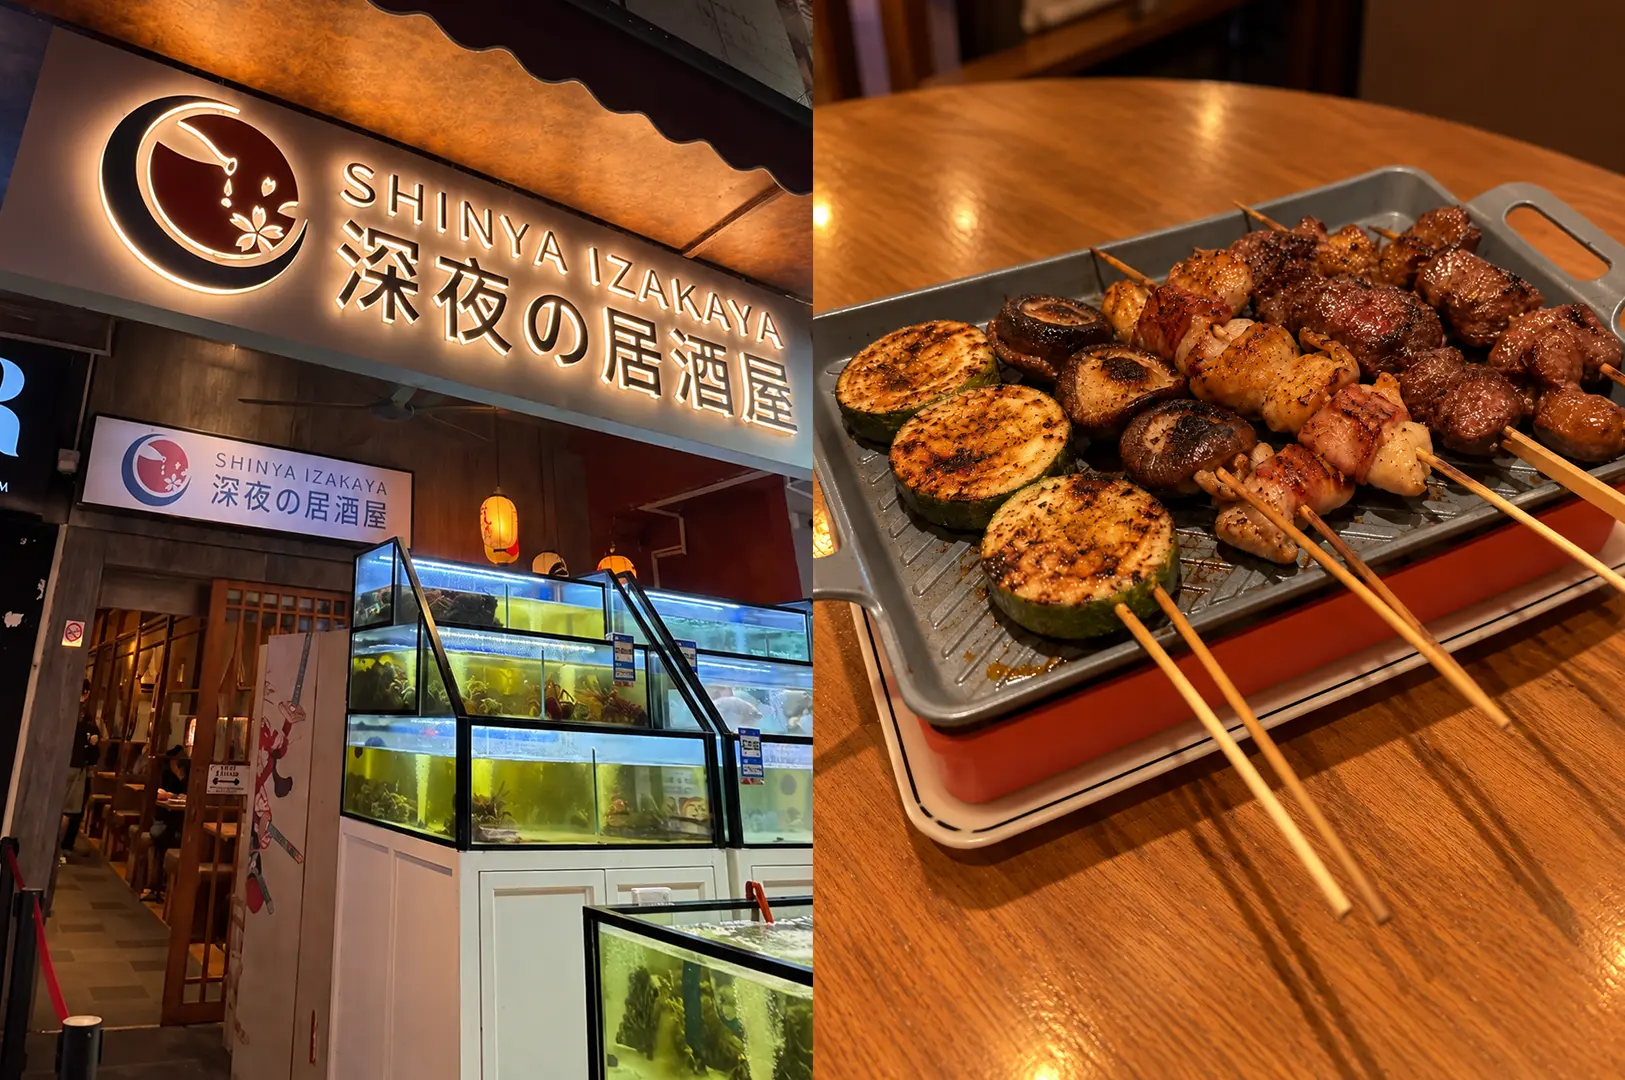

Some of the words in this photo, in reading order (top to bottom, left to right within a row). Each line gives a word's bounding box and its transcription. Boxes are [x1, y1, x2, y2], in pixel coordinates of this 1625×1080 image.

[340, 162, 568, 275] SHINYA
[588, 246, 785, 349] IZAKAYA
[336, 218, 798, 435] 深夜の居酒屋
[211, 473, 387, 530] 深夜の居酒屋
[215, 452, 296, 480] SHINYA
[305, 468, 388, 496] IZAKAYA
